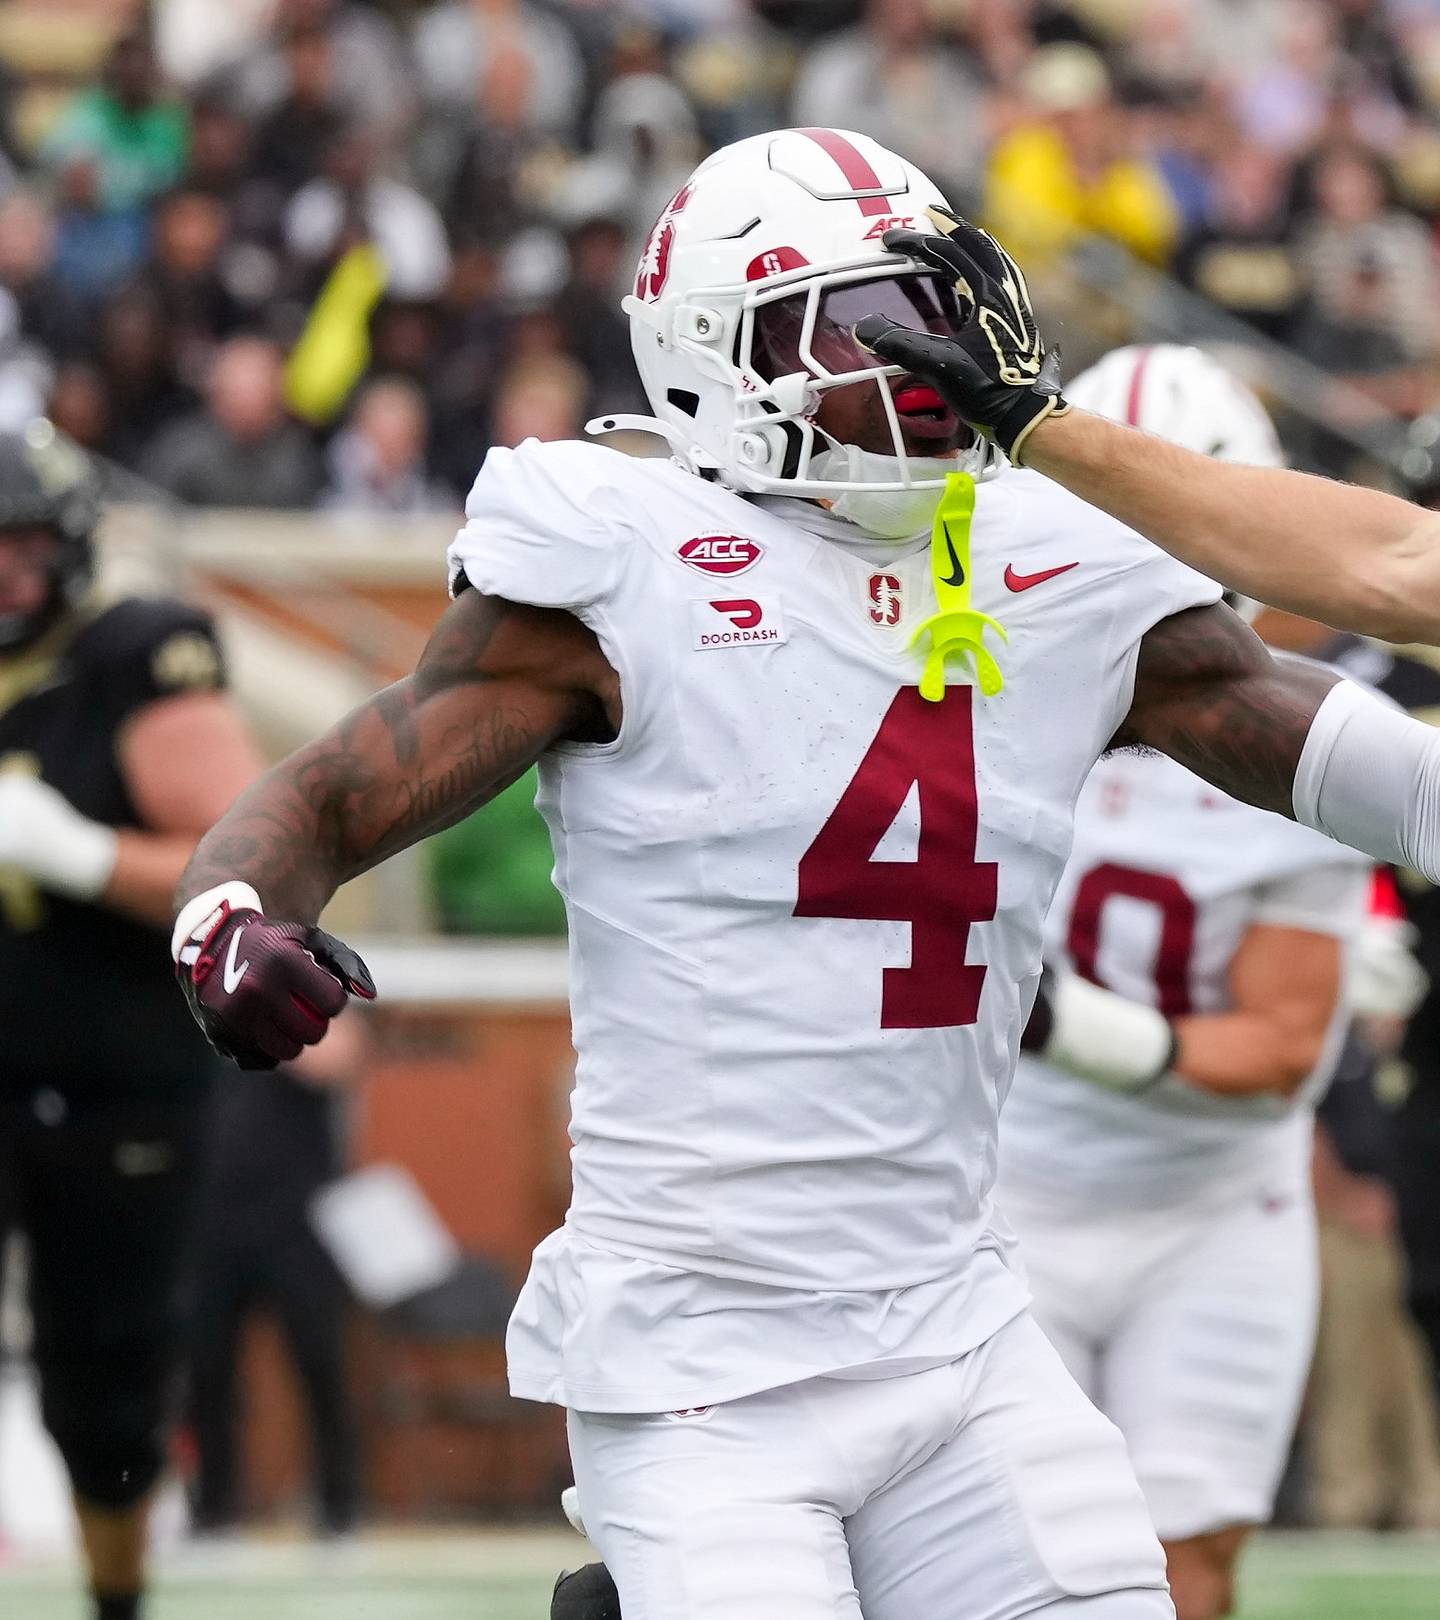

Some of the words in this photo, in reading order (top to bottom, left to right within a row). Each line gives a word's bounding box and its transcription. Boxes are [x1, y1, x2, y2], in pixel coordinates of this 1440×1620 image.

[686, 539, 751, 559] ACC
[701, 629, 778, 645] DOORDASH
[792, 684, 998, 1029] 4
